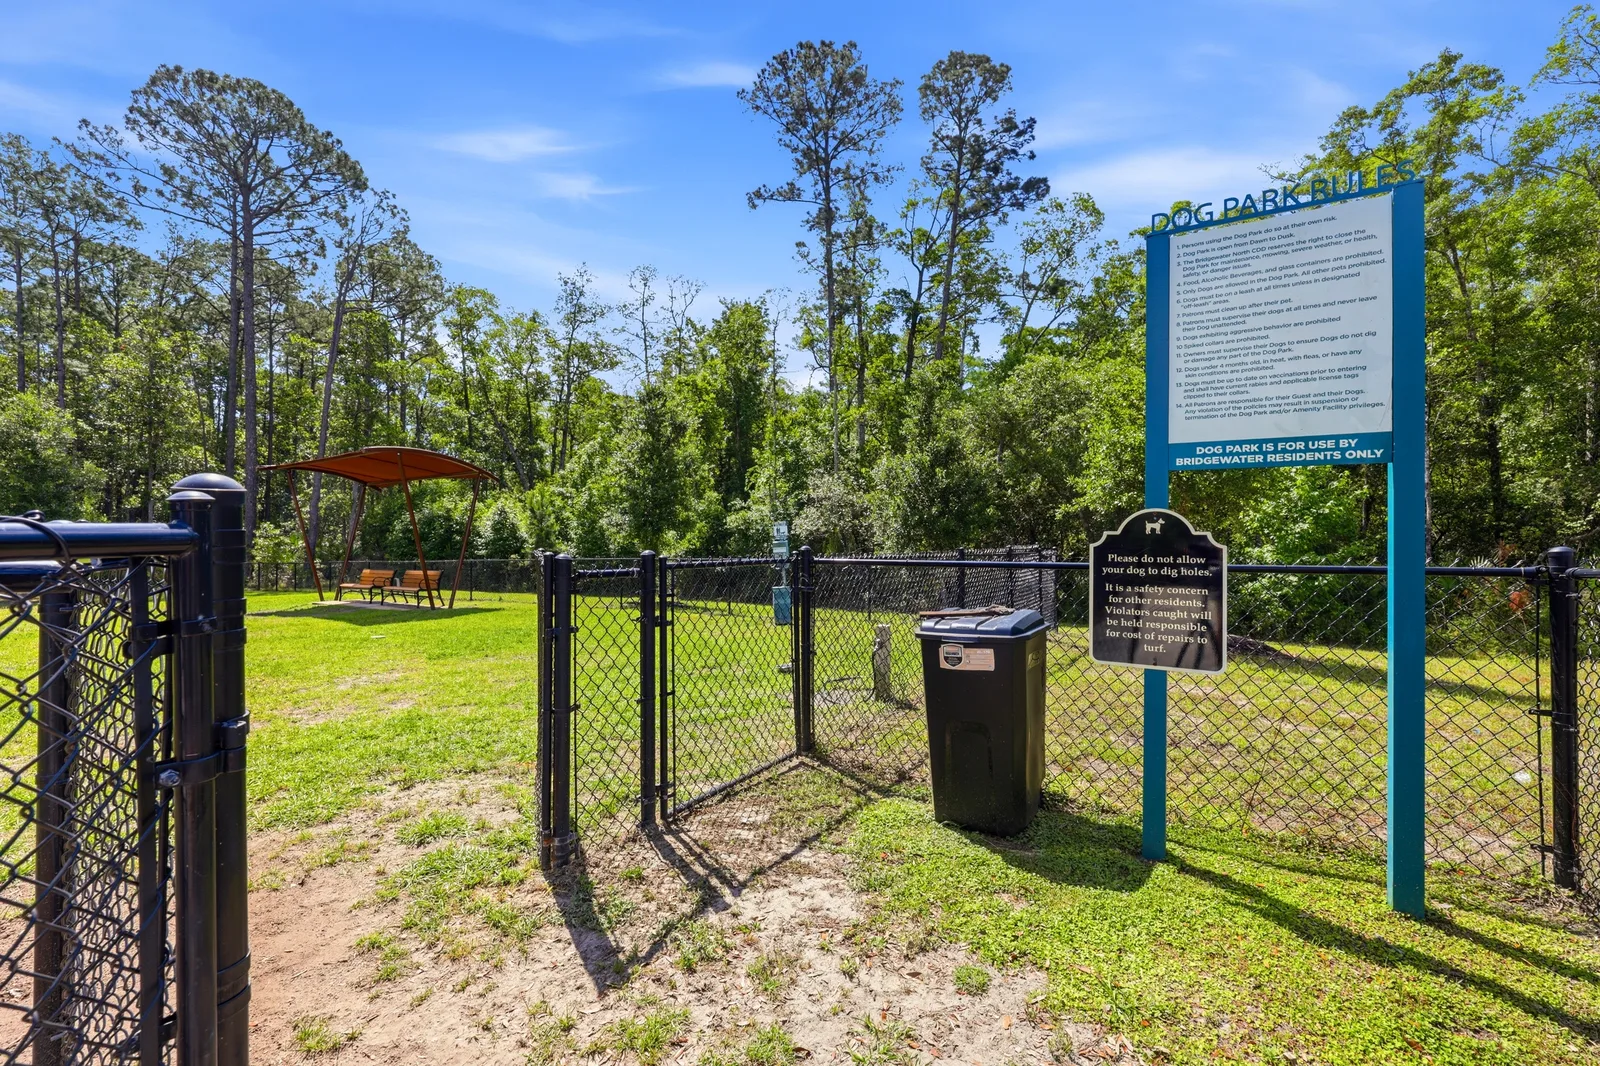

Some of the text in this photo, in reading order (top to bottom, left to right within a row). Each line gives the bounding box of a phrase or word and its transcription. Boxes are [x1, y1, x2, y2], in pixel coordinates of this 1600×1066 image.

[1151, 159, 1416, 233] DOG PARK RULES
[1201, 275, 1228, 283] Alcoholic
[1296, 258, 1331, 268] containers
[1229, 327, 1262, 335] aggressive
[1305, 316, 1341, 326] prohibited
[1196, 446, 1223, 455] DOG
[1226, 444, 1259, 453] PARK
[1278, 442, 1305, 450] FOR
[1308, 441, 1336, 449] USE
[1339, 439, 1359, 448] BY
[1176, 449, 1385, 466] BRIDGEWATER RESIDENTS ONLY
[1108, 554, 1138, 562] Please
[1176, 556, 1206, 564] allow
[1102, 567, 1124, 575] your
[1127, 566, 1146, 576] dog
[1161, 567, 1178, 577] dig
[1181, 568, 1212, 576] holes.
[1134, 585, 1164, 595] safety
[1108, 595, 1205, 607] for other residents.
[1105, 606, 1150, 616] Violators
[1153, 610, 1188, 620] caught
[1121, 619, 1143, 628] held
[1146, 622, 1207, 632] responsible
[1158, 634, 1194, 643] repairs
[1144, 644, 1166, 652] turf.
